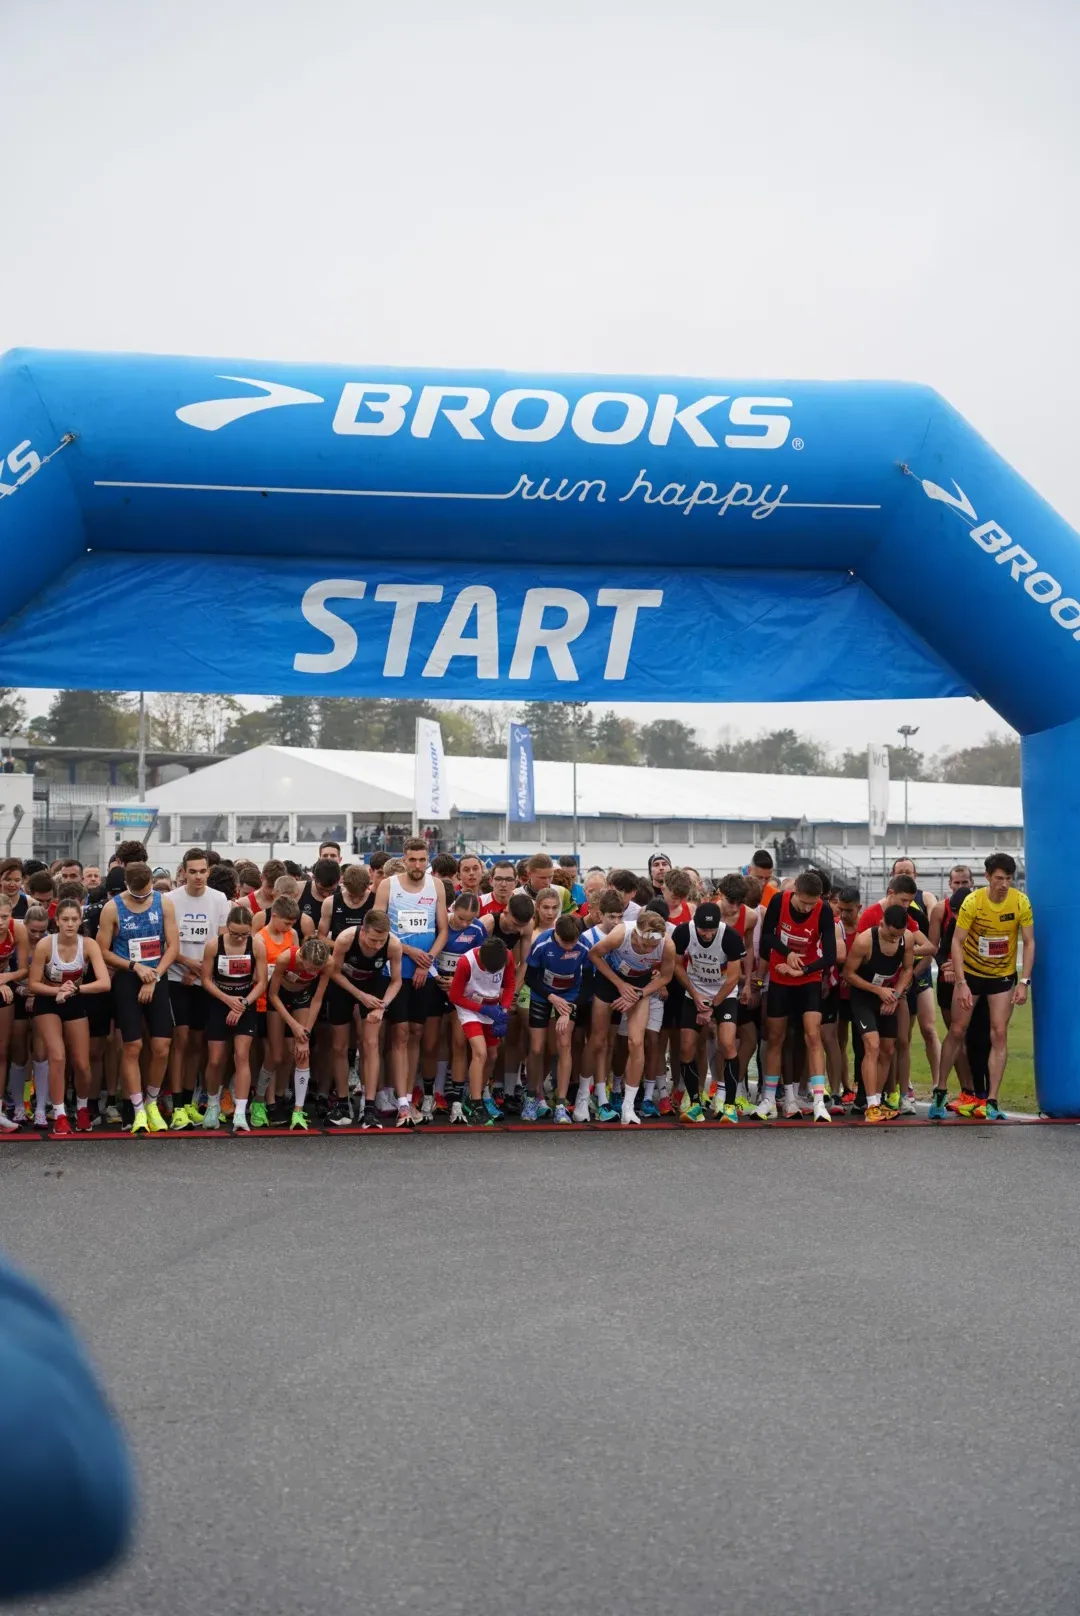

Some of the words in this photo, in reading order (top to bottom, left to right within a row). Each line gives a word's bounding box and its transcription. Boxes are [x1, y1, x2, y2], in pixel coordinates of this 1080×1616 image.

[332, 382, 793, 449] BROOKS
[508, 473, 606, 502] run
[618, 469, 789, 520] happy
[969, 519, 1080, 641] BROO
[293, 579, 664, 681] START
[430, 741, 441, 815] FAN-SHOP
[518, 745, 528, 818] FAN-SHOP
[190, 927, 208, 935] 1491
[409, 918, 428, 927] 1517
[701, 967, 720, 975] 1441
